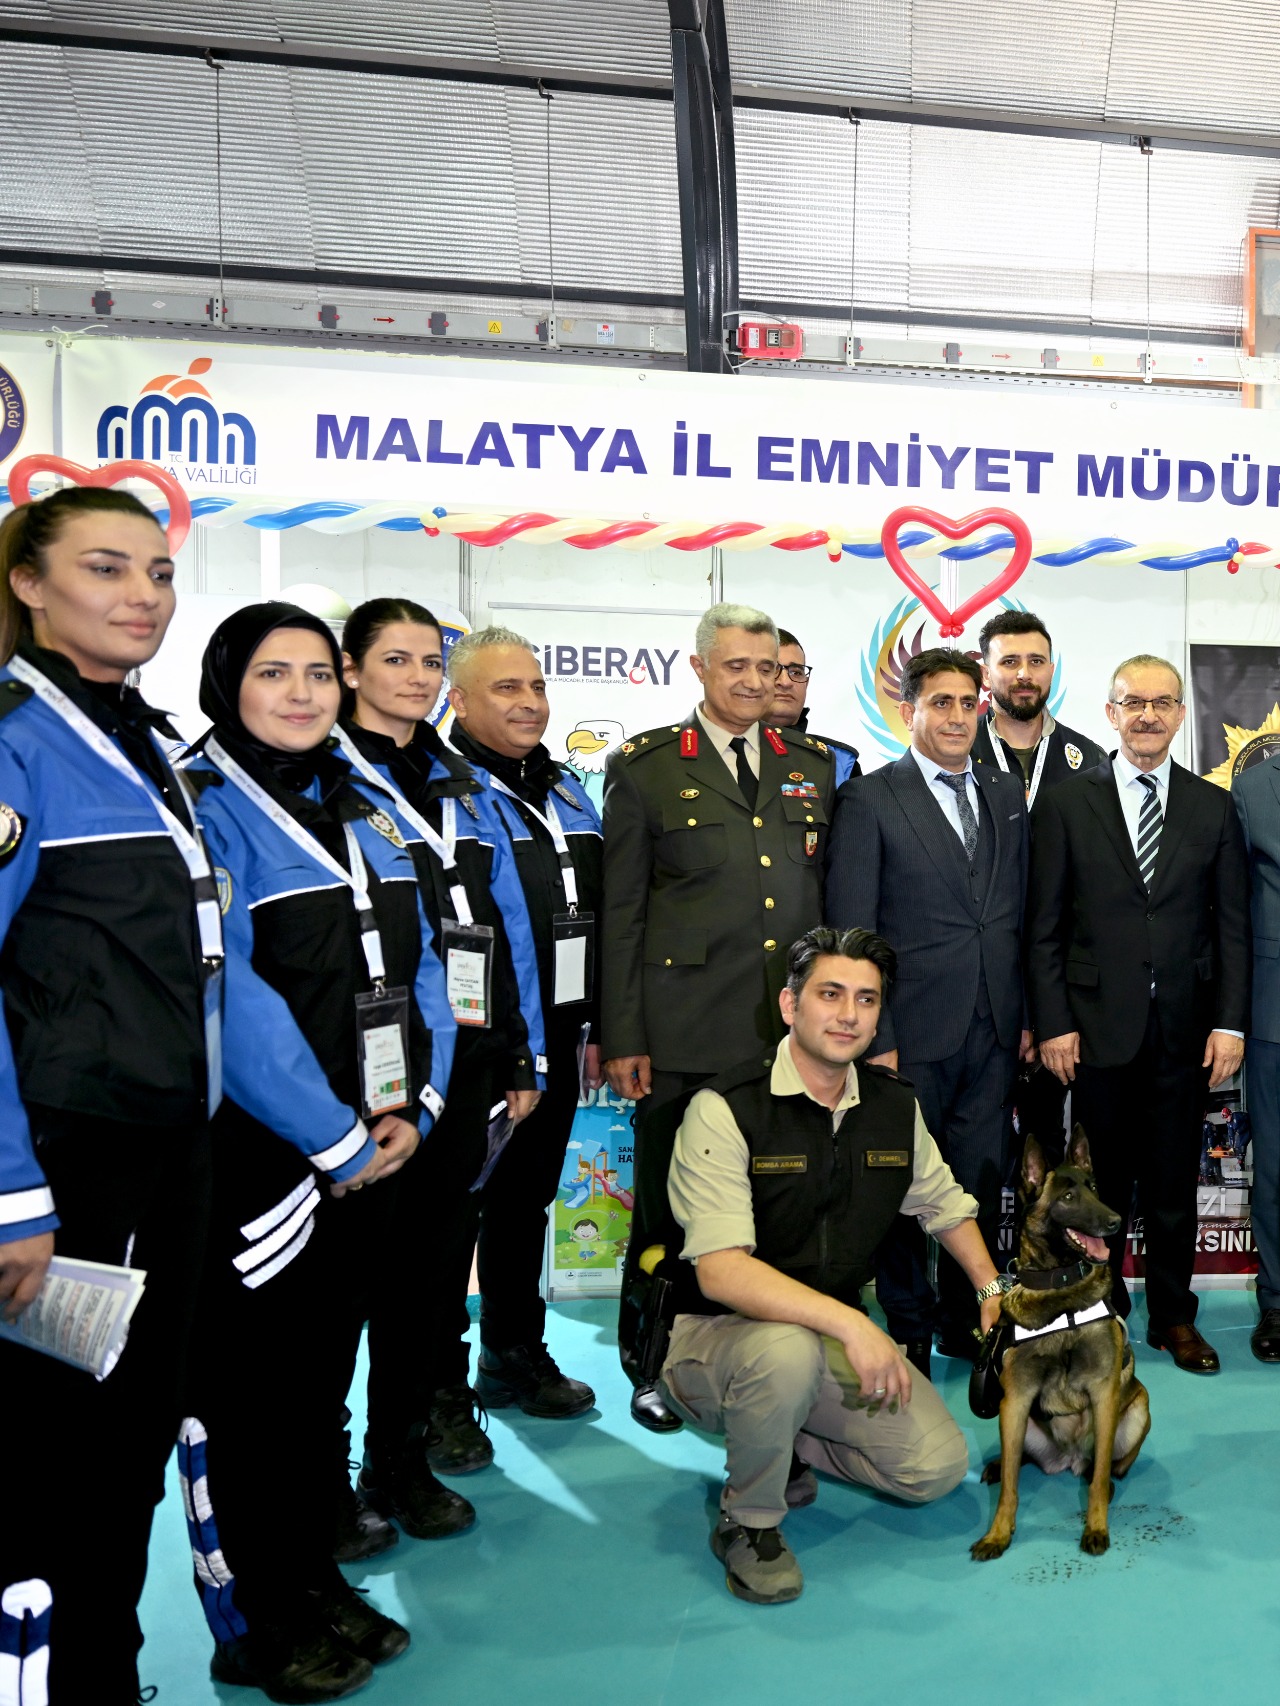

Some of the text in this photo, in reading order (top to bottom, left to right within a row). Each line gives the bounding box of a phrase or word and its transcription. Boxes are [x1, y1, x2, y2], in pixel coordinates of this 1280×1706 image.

[316, 413, 648, 475] MALATYA
[673, 420, 732, 479] İL
[757, 432, 1054, 494] EMNİYET
[186, 466, 257, 485] VALİLİĞİ
[756, 1160, 804, 1169] BOMBA ARAMA
